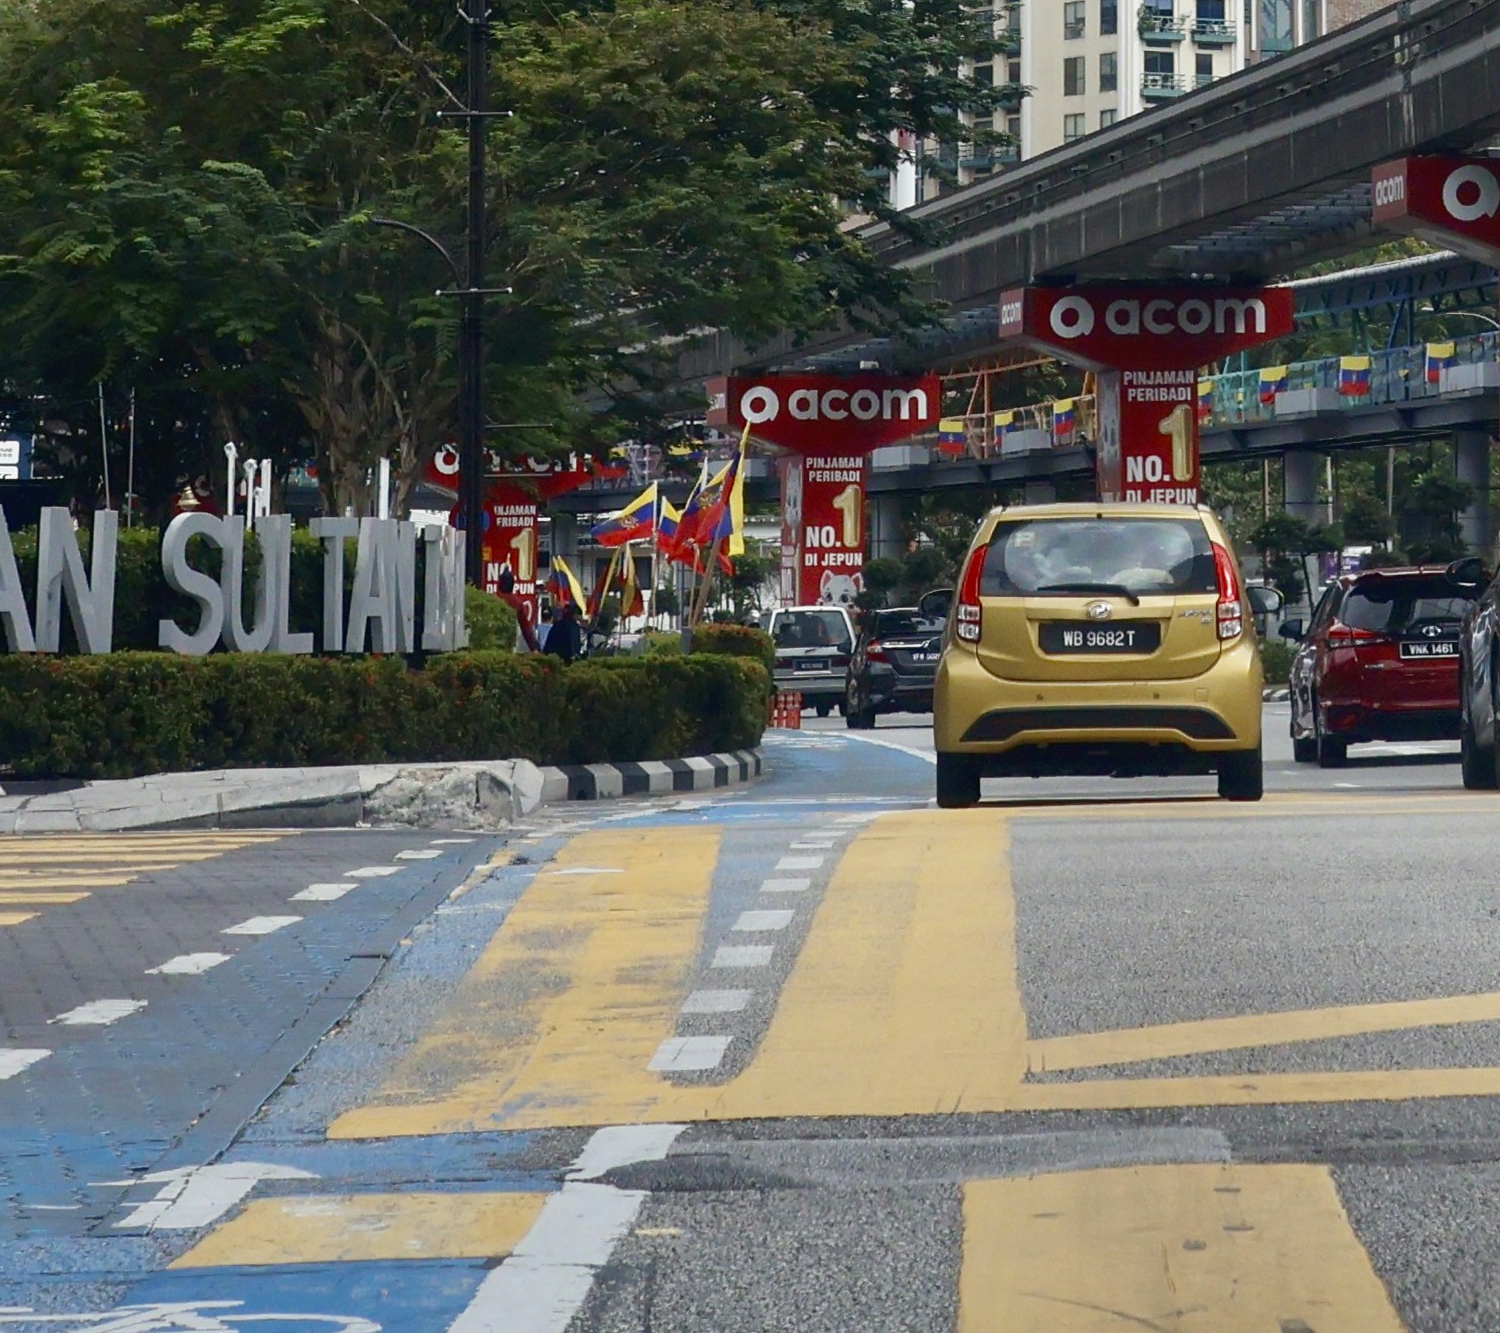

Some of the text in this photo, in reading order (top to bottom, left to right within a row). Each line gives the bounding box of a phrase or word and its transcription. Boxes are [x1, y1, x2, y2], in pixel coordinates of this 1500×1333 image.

[1375, 175, 1404, 205] acom
[1105, 298, 1266, 334] acom
[1124, 370, 1194, 385] PINJAMAN
[1128, 387, 1192, 402] PERIBADI
[788, 388, 927, 421] acom
[806, 457, 863, 469] PINJAMAN
[809, 470, 860, 482] PERIBADI
[1126, 488, 1197, 503] DI JEPUN
[805, 553, 817, 566] DI
[822, 552, 862, 566] JEPUN
[1063, 630, 1083, 647] WB
[1086, 630, 1124, 647] 9682
[1431, 643, 1453, 654] 1461
